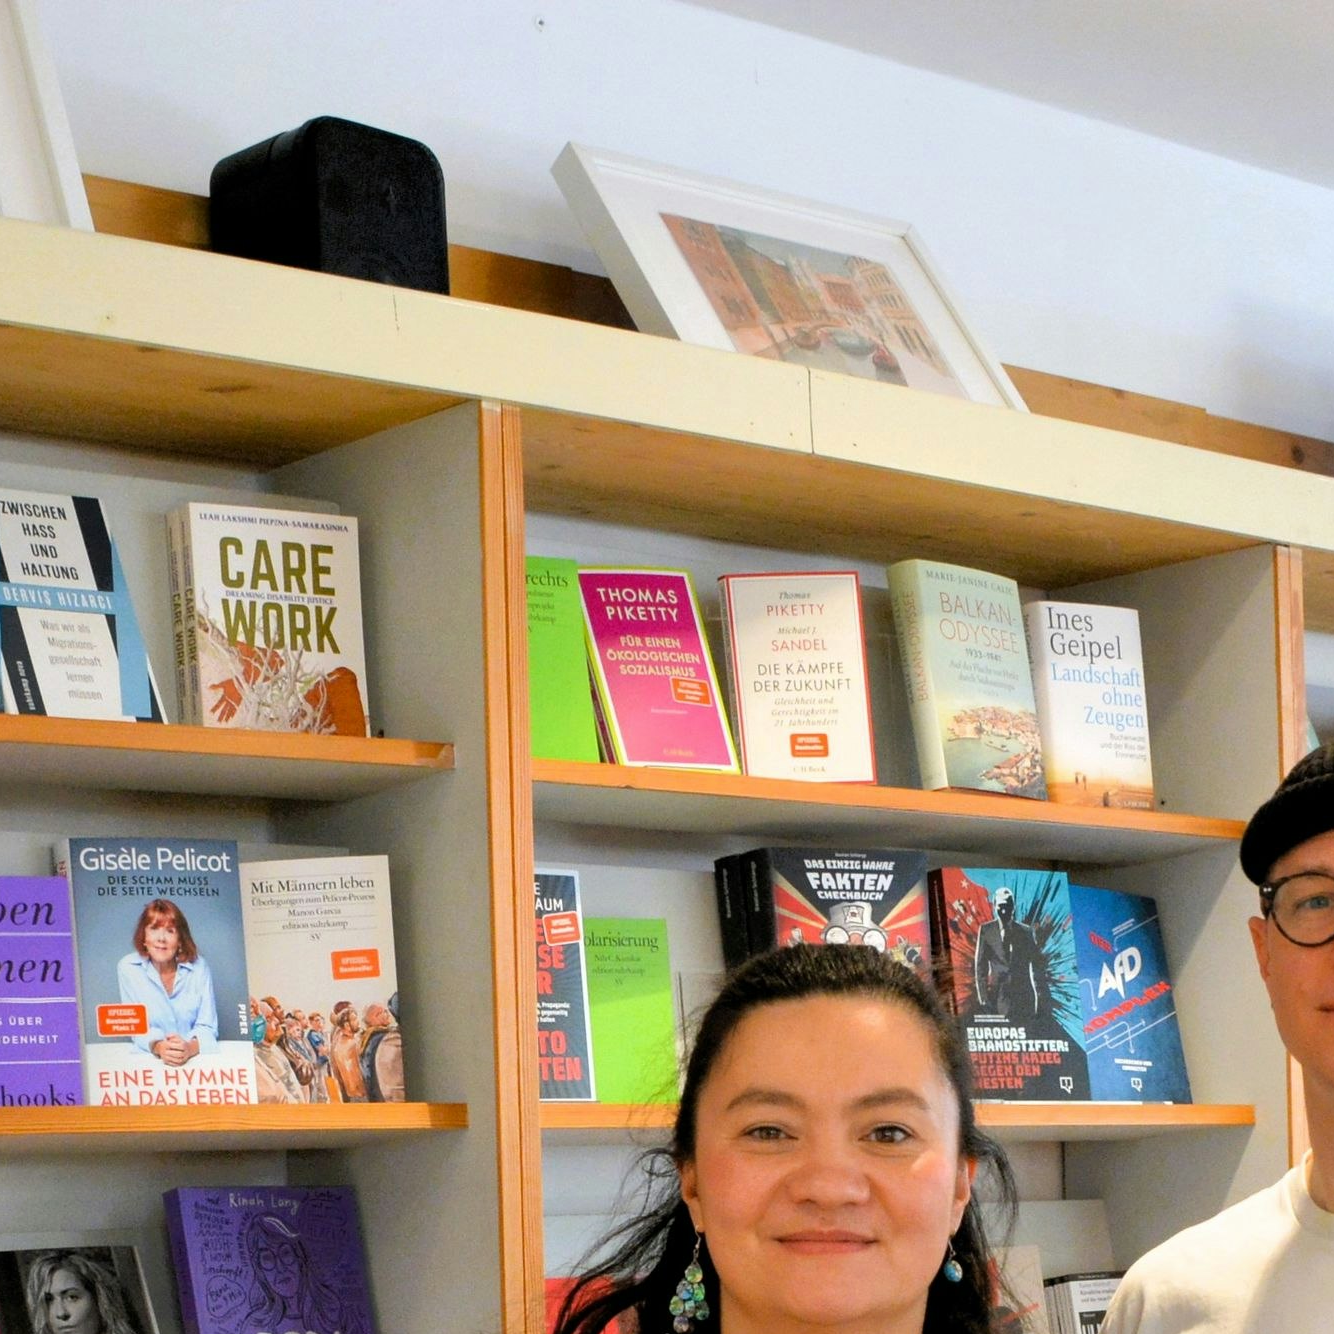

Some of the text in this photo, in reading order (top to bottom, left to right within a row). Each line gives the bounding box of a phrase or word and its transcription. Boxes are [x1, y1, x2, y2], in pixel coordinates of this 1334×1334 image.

[0, 500, 67, 521] ZWISCHEN
[22, 522, 57, 539] HASS
[30, 543, 58, 559] UND
[21, 561, 80, 581] HALTUNG
[219, 536, 336, 597] CARE
[2, 586, 112, 610] DERVIS HIZARCI
[597, 588, 678, 605] THOMAS
[606, 606, 679, 622] PIKETTY
[767, 603, 825, 617] PIKETTY
[1046, 607, 1093, 632] Ines
[221, 598, 340, 654] WORK
[771, 639, 828, 651] SANDEL
[1050, 632, 1122, 665] Geipel
[1050, 662, 1140, 688] Landschaft
[1102, 689, 1143, 708] ohne
[1083, 706, 1145, 731] Zeugen
[79, 847, 231, 873] Gisèle Pelicot
[250, 877, 375, 894] Mit Männern leben
[805, 871, 894, 892] FAKTEN
[816, 889, 884, 900] CHECKBUCH
[237, 1003, 247, 1035] PIPER
[967, 1027, 1026, 1040] EUROPAS
[968, 1041, 1069, 1052] BRANDSTIFTER:
[229, 1193, 266, 1208] Rinah
